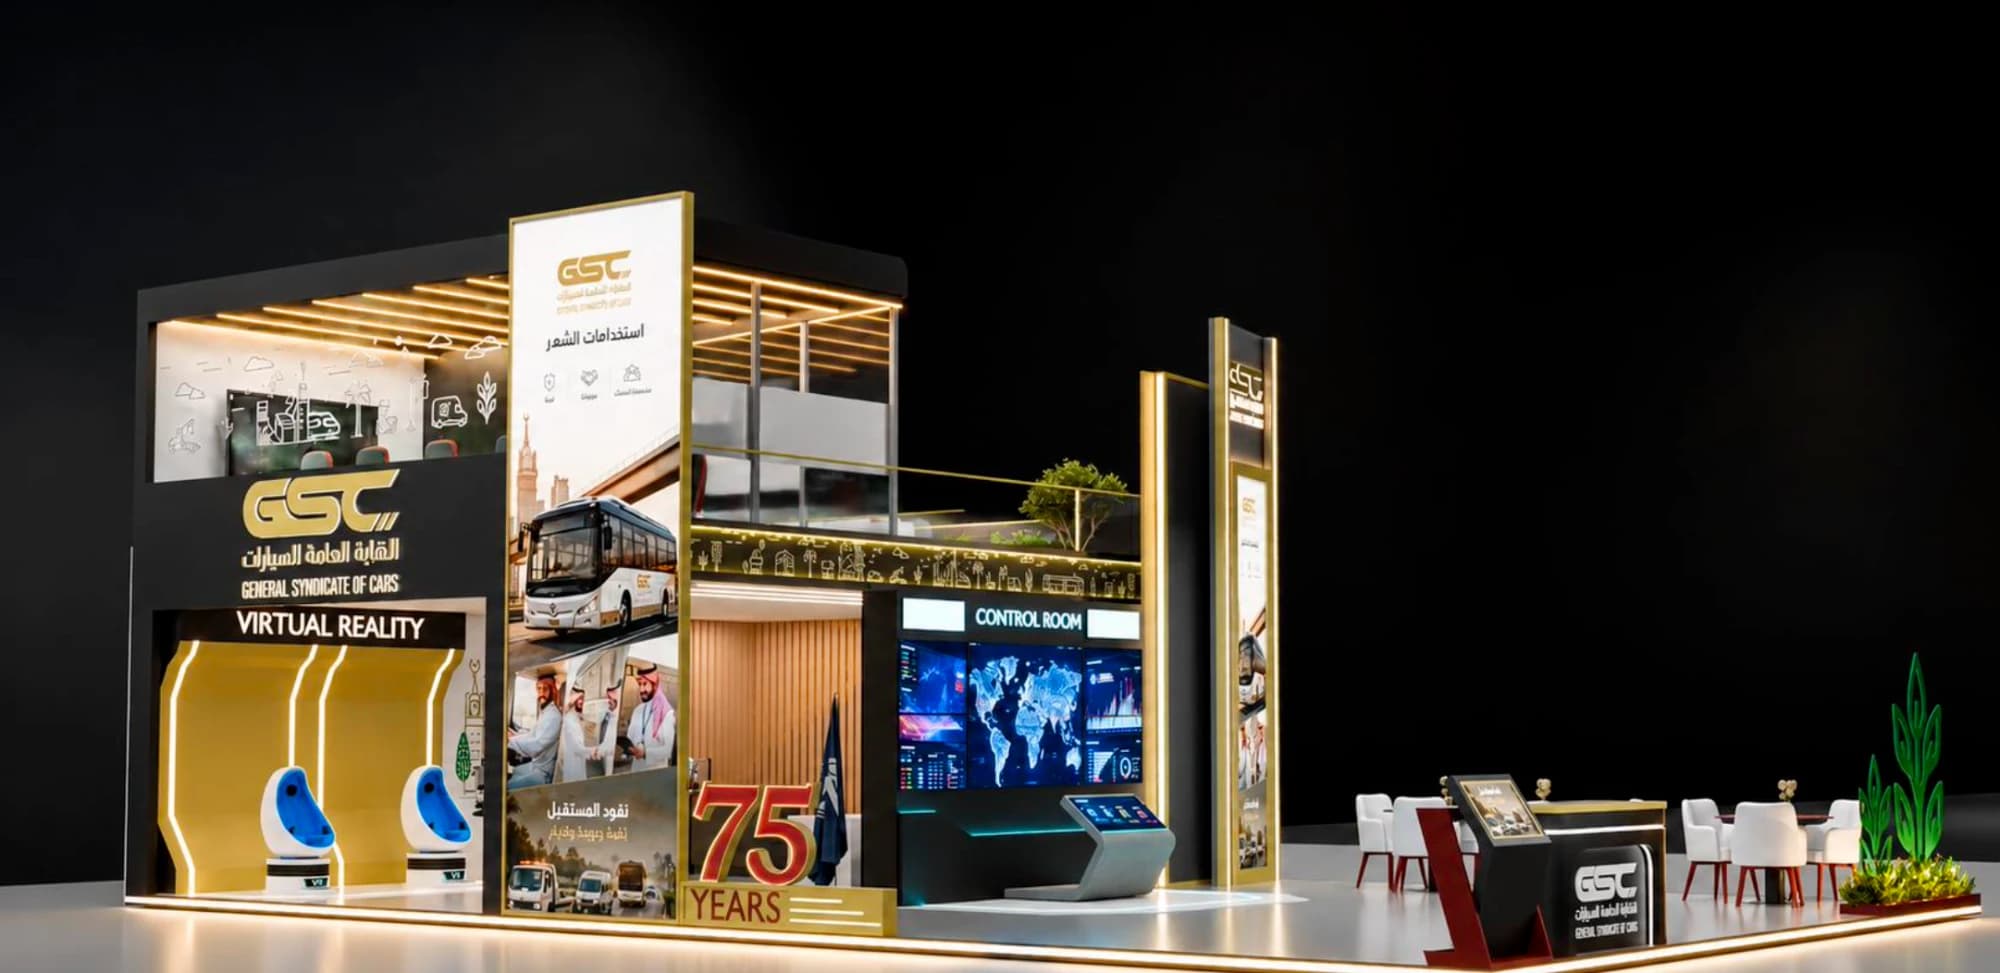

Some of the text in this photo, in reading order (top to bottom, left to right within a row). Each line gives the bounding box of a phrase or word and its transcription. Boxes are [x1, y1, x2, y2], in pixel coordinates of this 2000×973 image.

[557, 250, 631, 286] GSC
[582, 322, 645, 345] استخدامات
[243, 469, 400, 539] GSC
[242, 545, 301, 572] السيارات
[241, 573, 400, 600] GENERAL SYNDICATE OF CARS
[236, 610, 425, 640] VIRTUAL REALITY
[975, 607, 1082, 631] CONTROL ROOM
[547, 801, 600, 820] المستقبل
[692, 781, 816, 886] 75
[1575, 863, 1637, 902] GSC
[690, 888, 781, 924] YEARS
